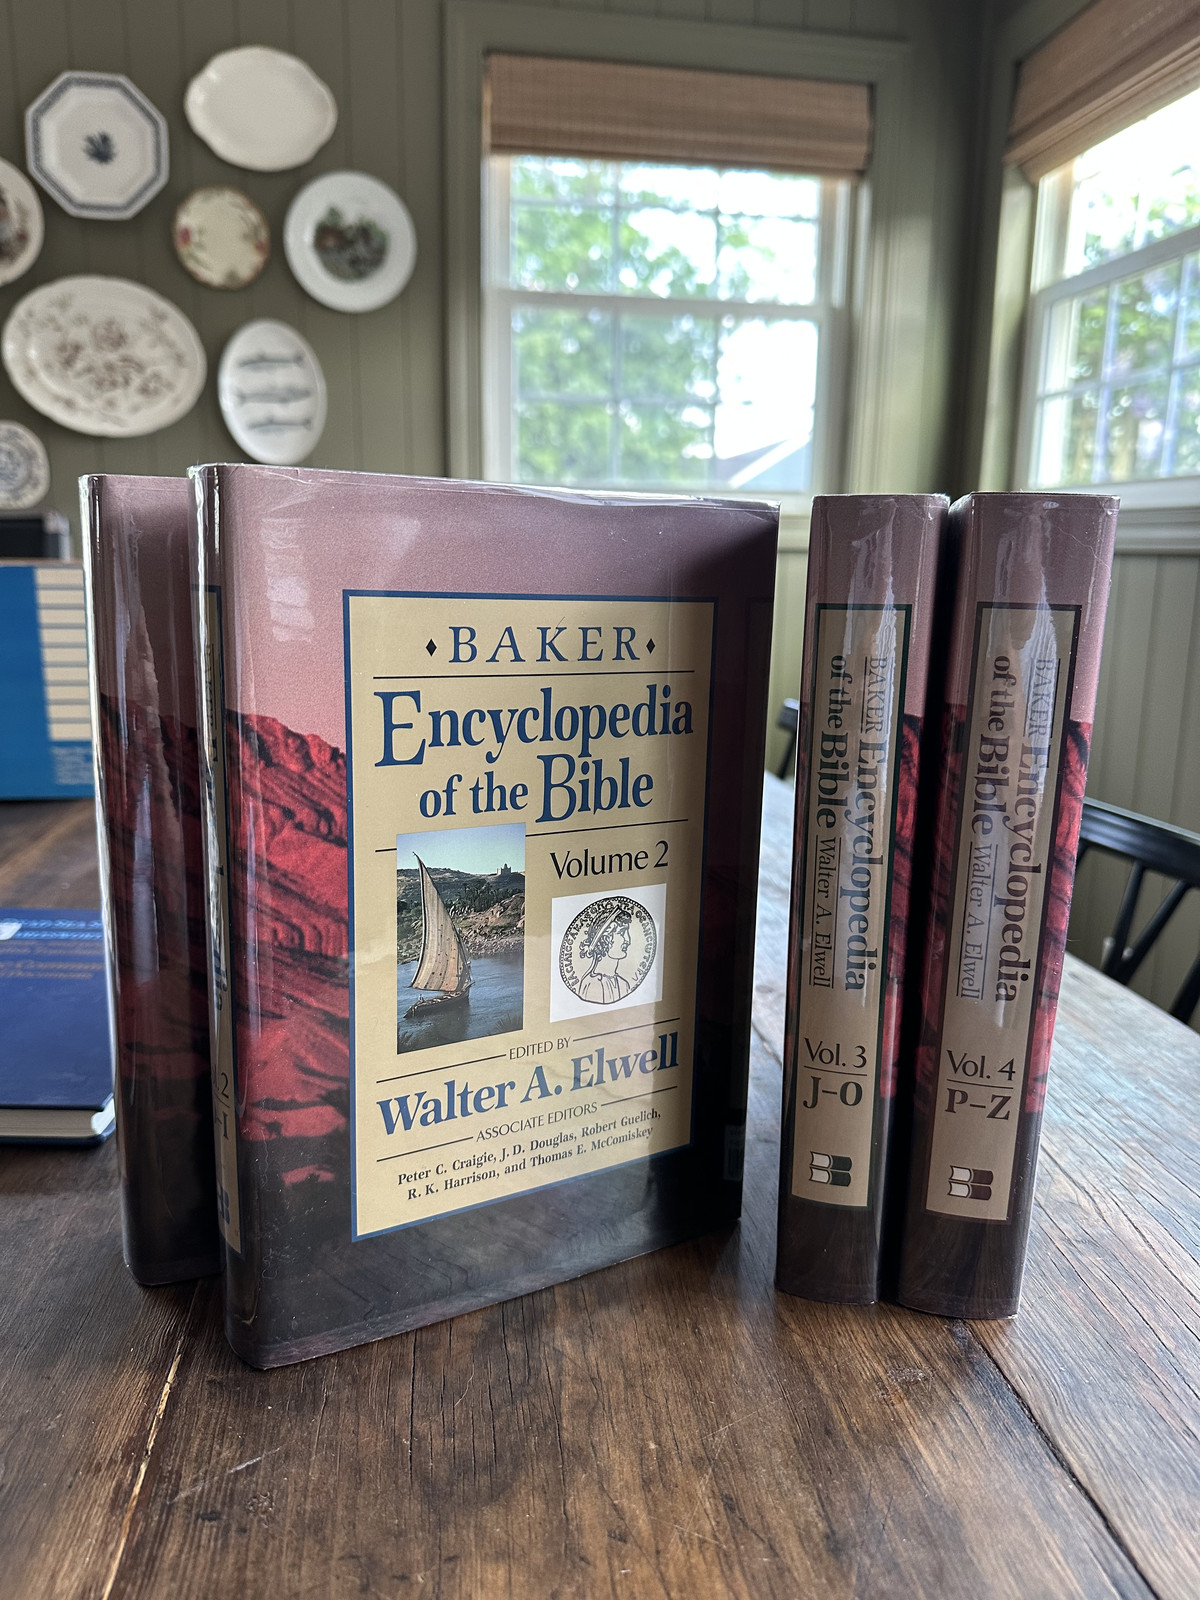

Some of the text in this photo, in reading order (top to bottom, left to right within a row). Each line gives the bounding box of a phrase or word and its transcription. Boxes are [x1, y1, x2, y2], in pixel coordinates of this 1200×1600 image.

[448, 625, 640, 663] BAKER
[373, 683, 694, 767] Encyclopedia
[815, 654, 853, 830] of the Bible
[971, 655, 1017, 836] of the Bible
[419, 753, 654, 823] of the Bible
[838, 656, 889, 992] BAKER Encyclopedia
[550, 840, 669, 880] Volume 2
[995, 657, 1053, 1003] BAKER Encyclopedia
[812, 836, 836, 989] Walter A. Elwell
[960, 843, 993, 1001] Walter A. Elwell
[376, 1031, 680, 1136] Walter A. Elwell
[509, 1036, 572, 1061] EDITED BY
[804, 1037, 867, 1068] Vol. 3
[946, 1050, 1016, 1081] Vol. 4
[398, 1107, 662, 1186] Peter C. Craigie, J. D. Douglas, Robert Guelich,
[475, 1102, 598, 1143] ASSOCIATE EDITORS
[407, 1125, 654, 1201] R. K. Harrison, and Thomas E. McComiskey
